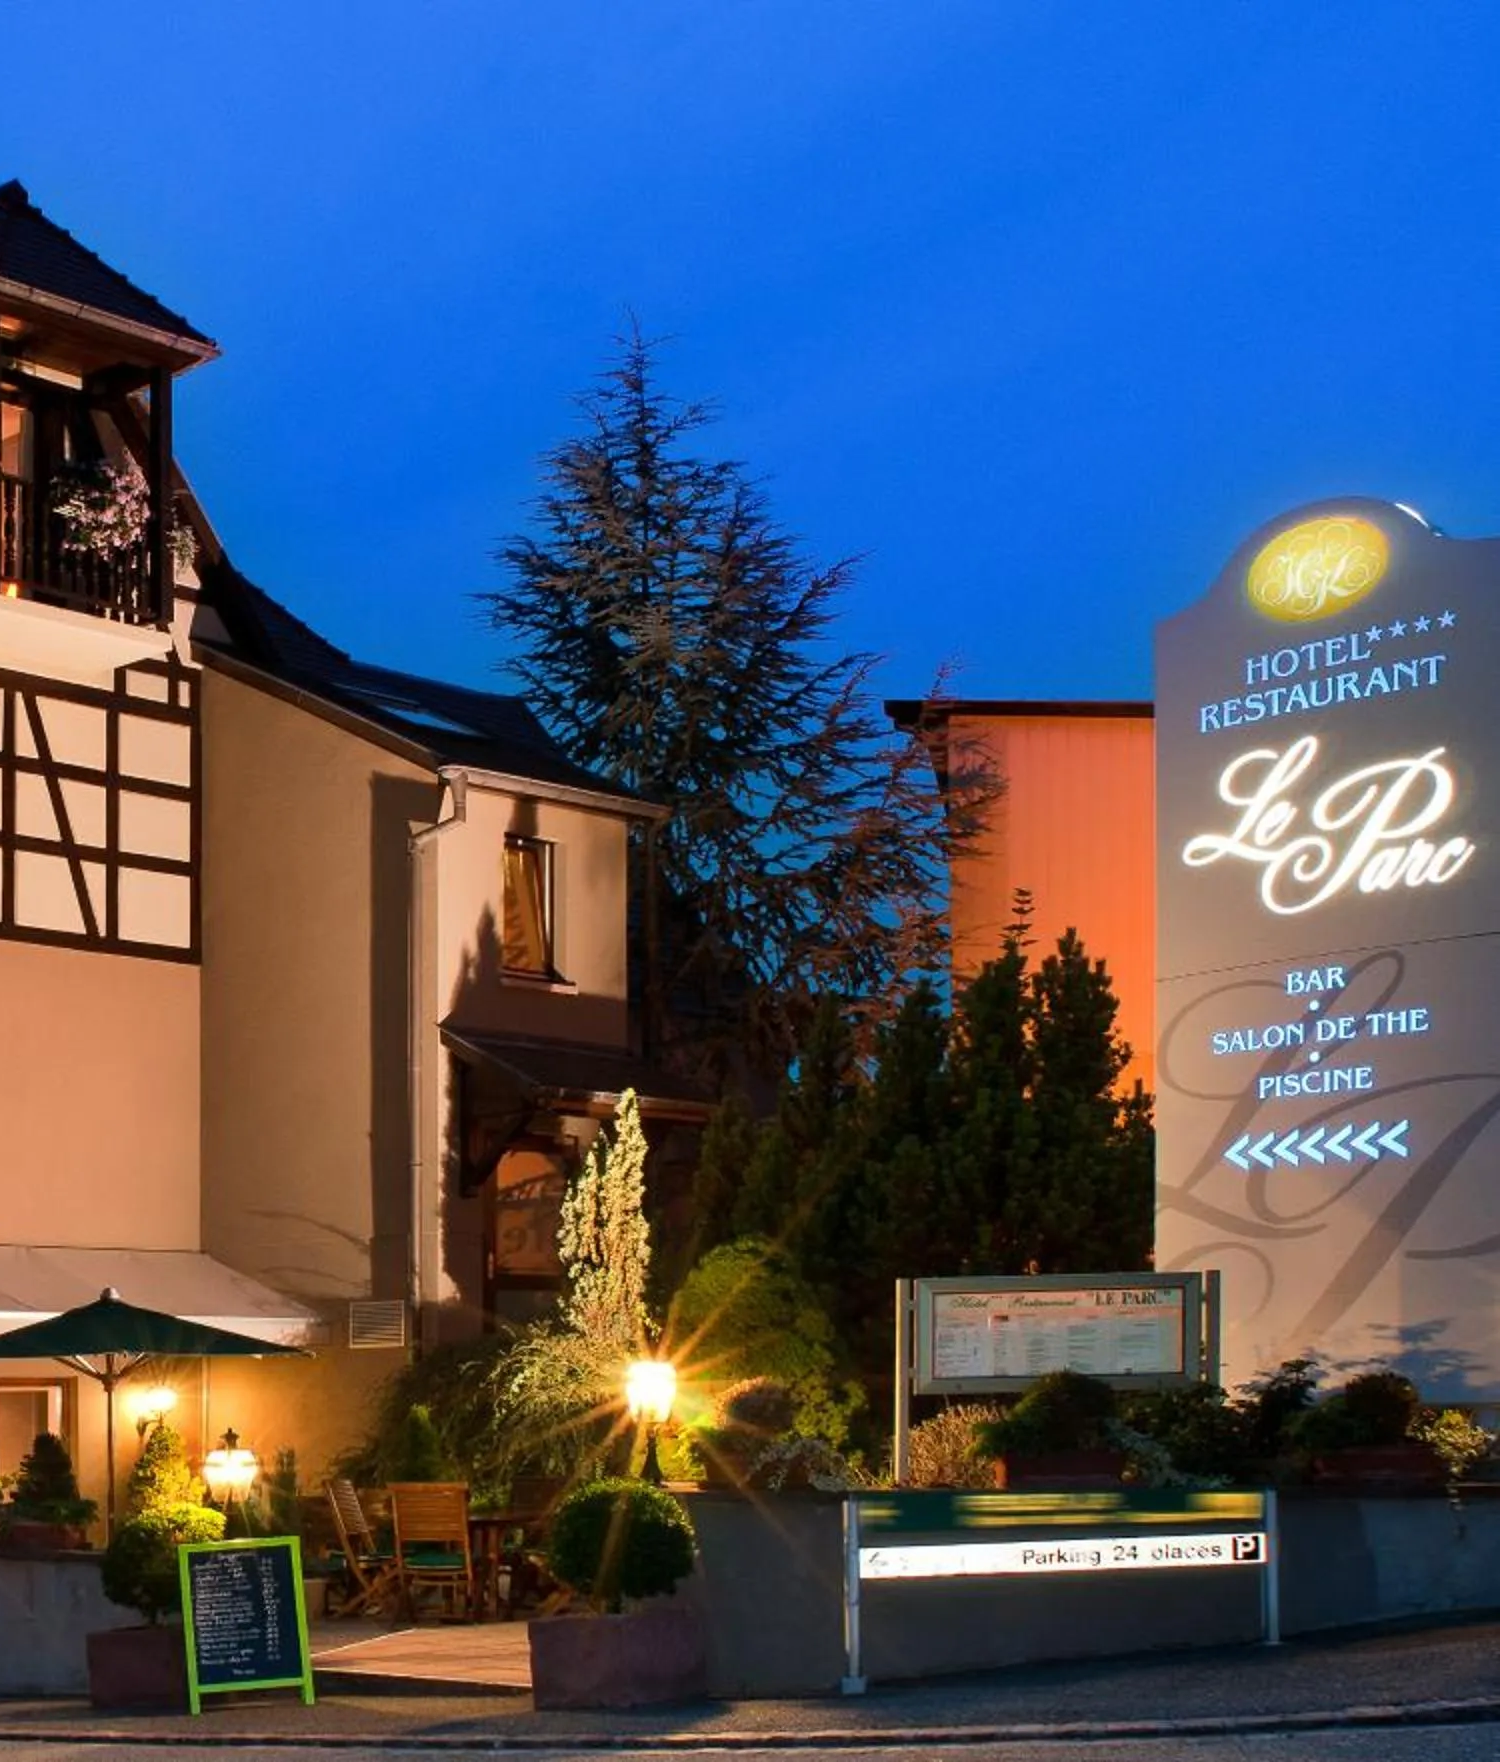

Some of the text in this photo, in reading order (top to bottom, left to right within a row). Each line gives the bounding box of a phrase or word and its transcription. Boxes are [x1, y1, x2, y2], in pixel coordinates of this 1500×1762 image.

[1246, 633, 1372, 685] HOTEL
[1200, 655, 1447, 733] RESTAURANT
[1182, 735, 1476, 915] Le Parc
[1286, 967, 1346, 994] BAR
[1212, 1008, 1429, 1054] SALON DE THE
[1259, 1066, 1373, 1099] PISCINE
[1022, 1549, 1101, 1566] Parking
[1112, 1545, 1139, 1561] 24
[1237, 1536, 1257, 1560] P
